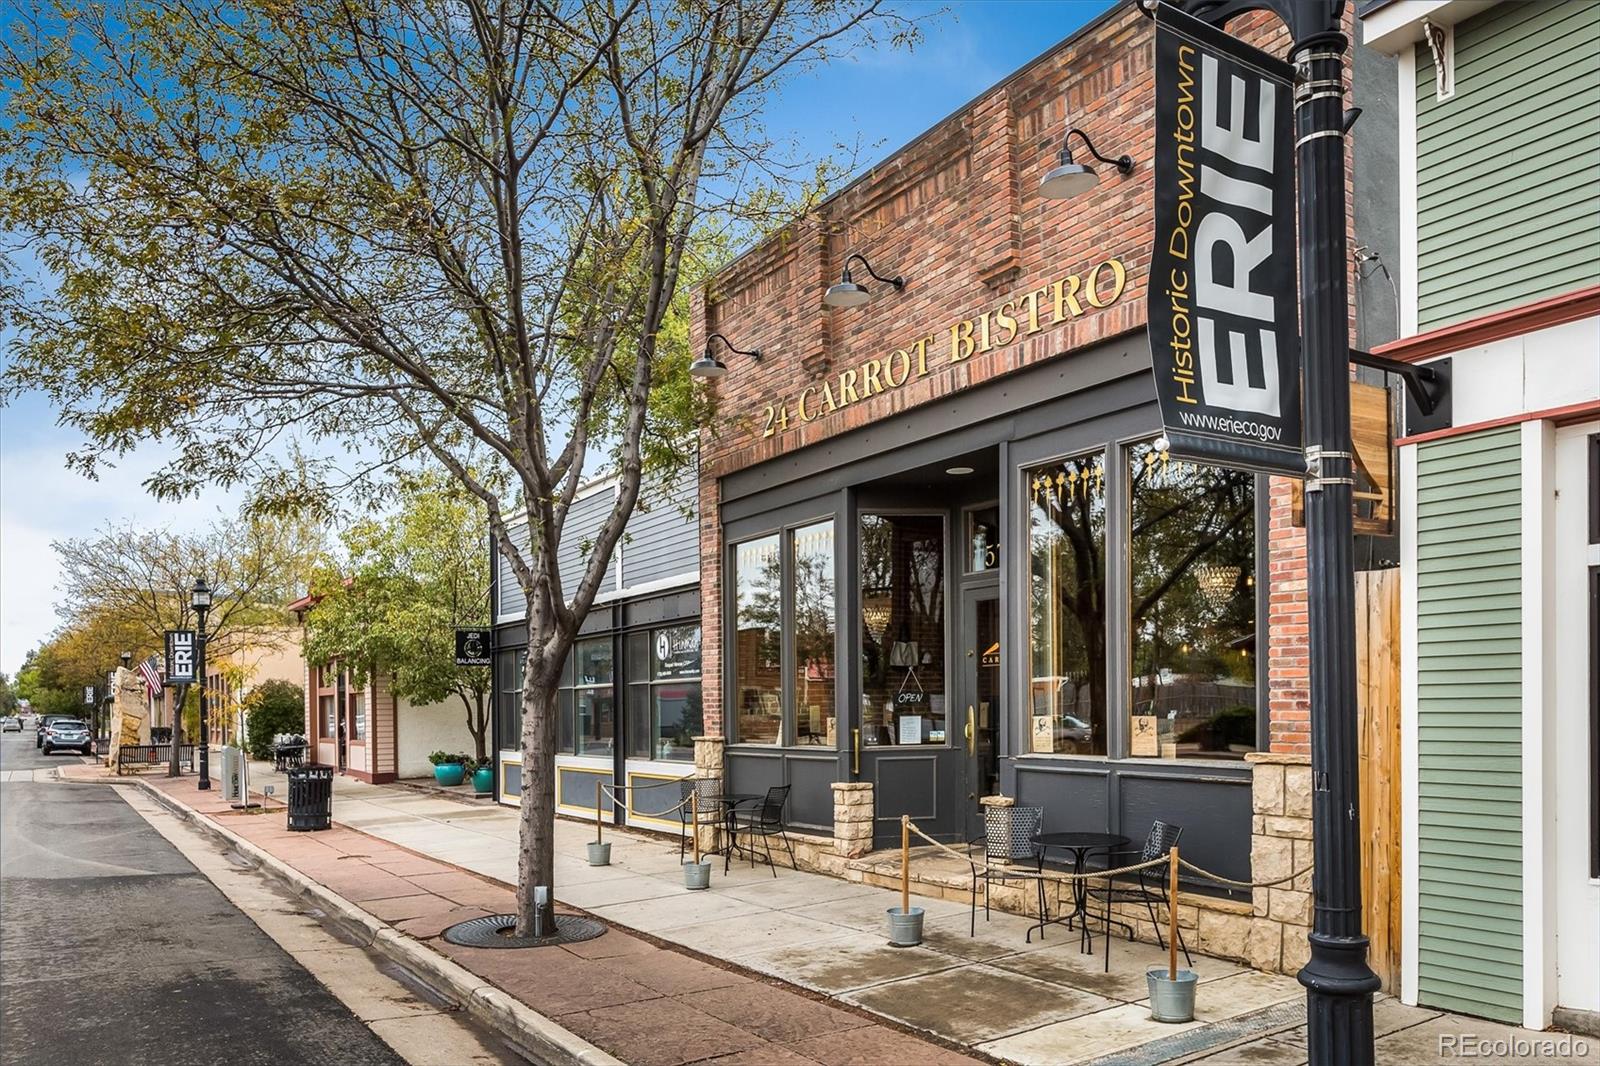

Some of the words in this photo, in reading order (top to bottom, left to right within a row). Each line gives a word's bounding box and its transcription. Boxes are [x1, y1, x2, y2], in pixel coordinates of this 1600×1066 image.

[1169, 45, 1195, 260] Downtown
[1194, 53, 1281, 417] ERIE
[762, 404, 789, 438] 24
[798, 333, 935, 422] CARROT
[949, 258, 1127, 364] BISTRO
[1166, 269, 1197, 405] Historic
[1179, 411, 1282, 441] www.erieco.gov
[985, 544, 1000, 567] 5
[174, 633, 193, 676] ERIE
[456, 657, 491, 665] BALANCING
[898, 692, 924, 703] OPEN
